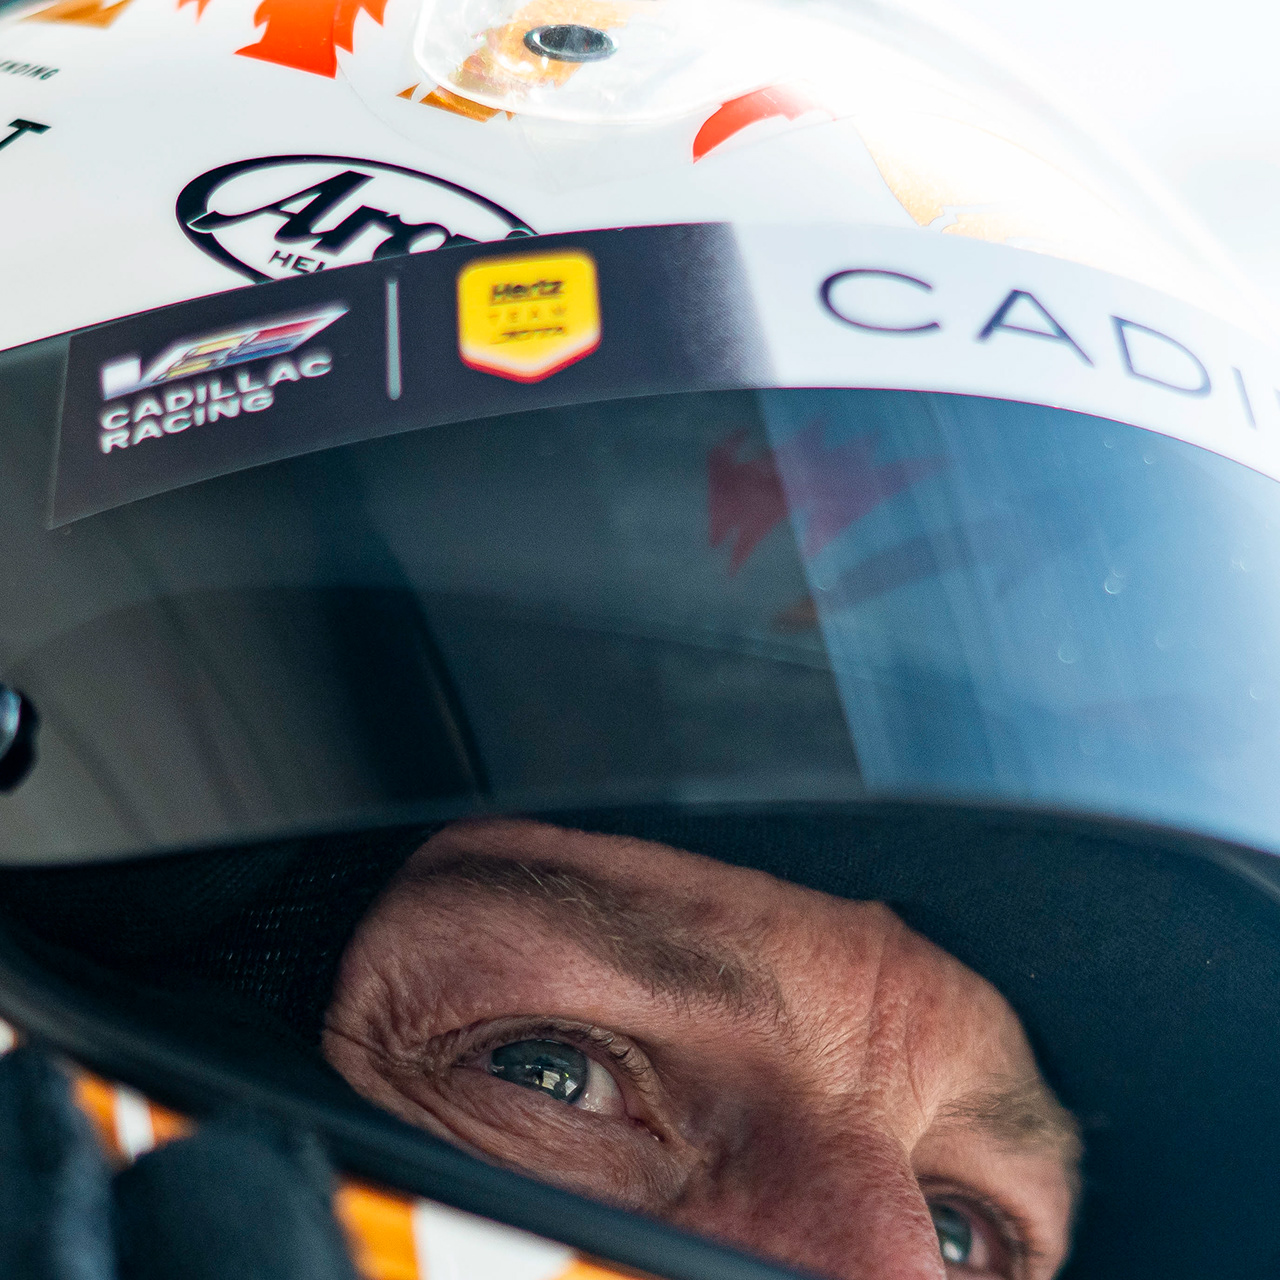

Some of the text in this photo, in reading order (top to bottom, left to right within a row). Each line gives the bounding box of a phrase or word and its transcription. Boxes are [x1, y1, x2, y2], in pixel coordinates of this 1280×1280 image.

[491, 278, 564, 304] Hertz
[100, 352, 332, 431] CADILLAC
[100, 389, 275, 454] RACING
